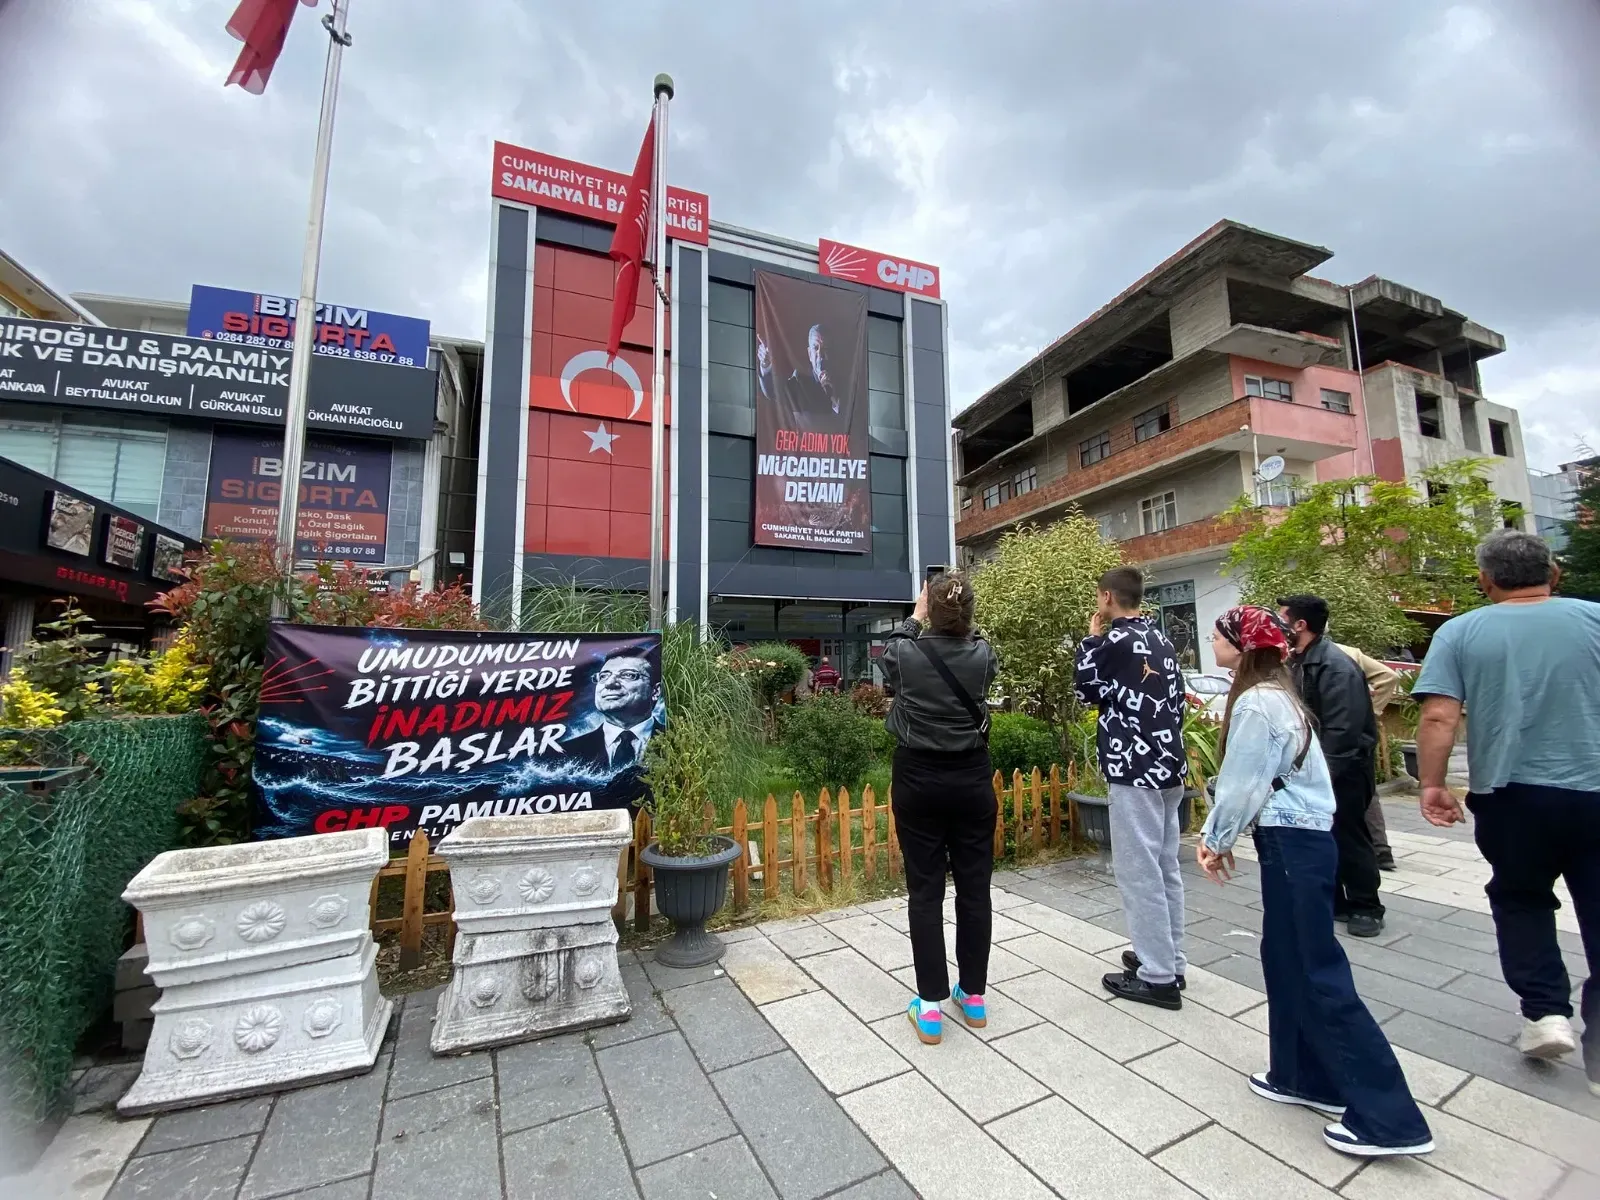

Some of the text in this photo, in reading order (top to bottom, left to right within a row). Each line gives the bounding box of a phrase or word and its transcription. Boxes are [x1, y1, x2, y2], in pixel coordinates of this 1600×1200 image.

[501, 155, 703, 215] CUMHURİYET HA RTİSİ
[501, 172, 585, 206] SAKARYA
[588, 191, 603, 209] İL
[877, 259, 936, 291] CHP
[138, 339, 160, 356] &
[171, 342, 290, 370] PALMİY
[216, 331, 244, 343] 0264
[246, 335, 266, 346] 282
[268, 339, 282, 349] 07
[319, 344, 350, 357] 0542
[354, 350, 377, 361] 636
[380, 353, 396, 364] 07
[398, 355, 414, 367] 88
[33, 344, 74, 363] VE
[82, 349, 290, 387] DANIŞMANLIK
[65, 386, 182, 407] BEYTULLAH OLKUN
[101, 377, 150, 391] AVUKAT
[219, 390, 265, 404] AVUKAT
[200, 399, 283, 417] GÜRKAN USLU
[308, 409, 403, 430] ÖKHAN HACIOĞLU
[330, 403, 373, 415] AVUKAT
[775, 429, 850, 457] GERİ ADIM YOK,
[259, 457, 357, 483] BZİM
[757, 453, 868, 480] MÜCADELEYE
[784, 481, 845, 504] DEVAM
[761, 523, 865, 539] CUMHURİYET HALK PARTİSİ
[774, 532, 805, 541] SAKARYA
[357, 637, 581, 674] UMUDUMUZUN
[342, 665, 576, 709] BİTTİĞİ YERDE
[367, 690, 575, 748] İNADIMIZ
[378, 723, 569, 780] BAŞLAR
[314, 791, 594, 835] CHP PAMUKOVA
